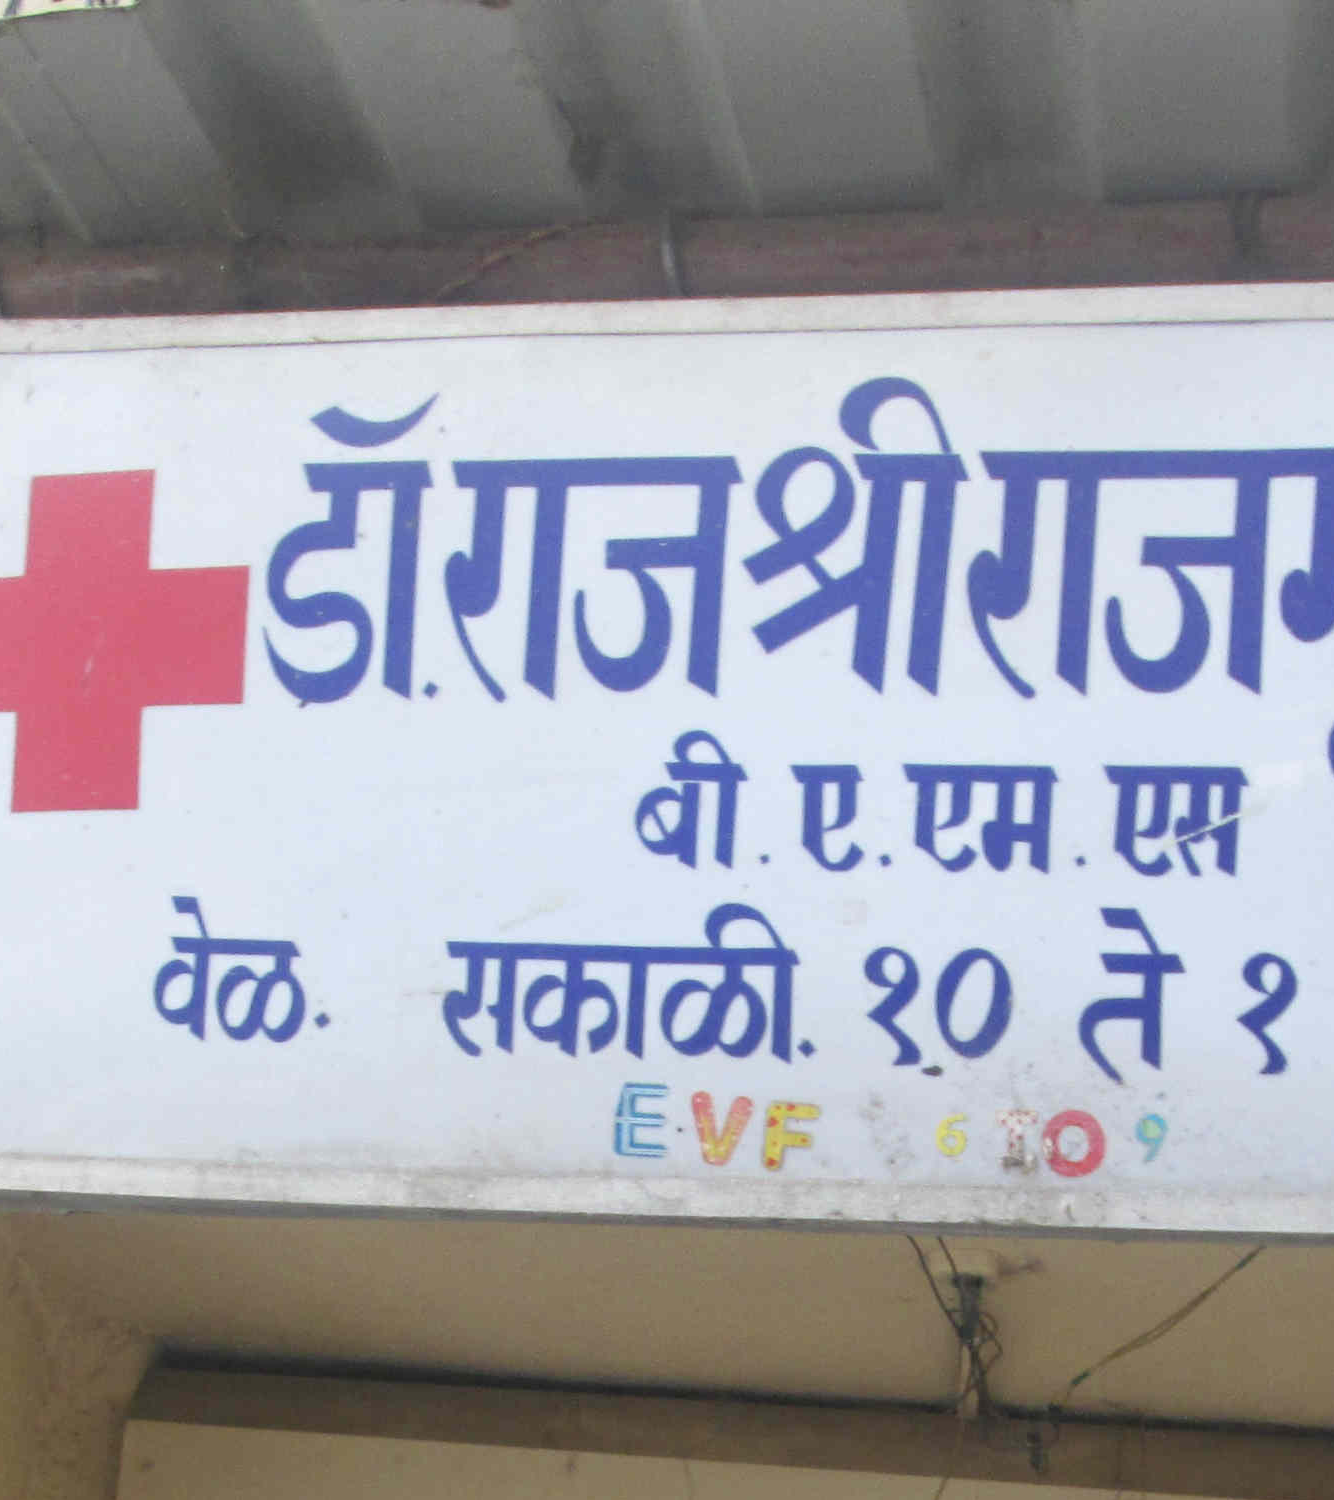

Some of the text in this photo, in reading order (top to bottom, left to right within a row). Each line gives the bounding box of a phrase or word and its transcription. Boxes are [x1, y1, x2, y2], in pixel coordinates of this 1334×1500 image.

[864, 947, 1013, 1067] १०
[1079, 908, 1186, 1085] ते
[1237, 952, 1298, 1076] १
[935, 1113, 969, 1158] 6
[1135, 1113, 1169, 1164] 9
